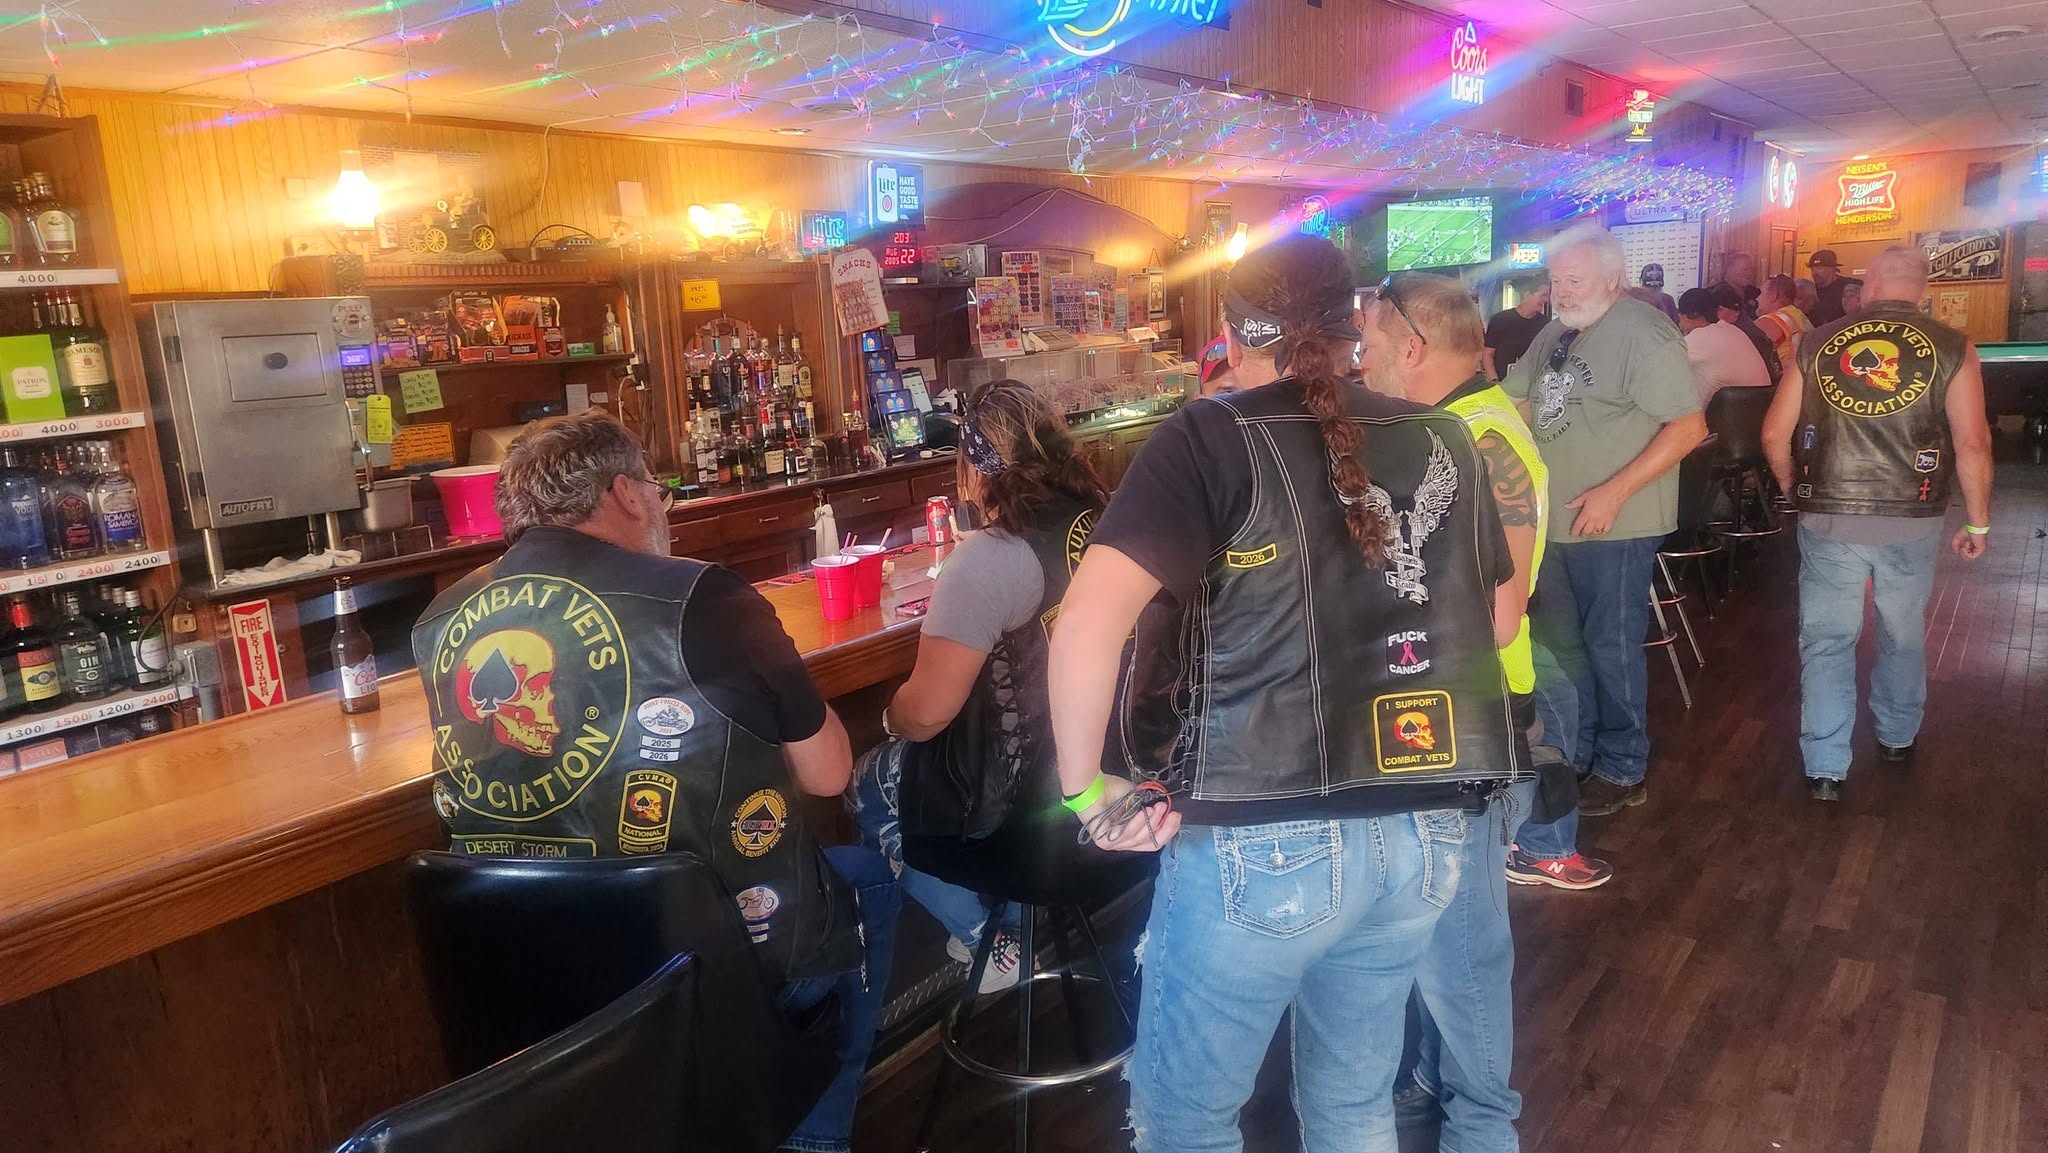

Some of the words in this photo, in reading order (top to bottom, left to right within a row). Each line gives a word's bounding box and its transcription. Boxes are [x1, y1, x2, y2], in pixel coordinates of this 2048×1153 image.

[1450, 26, 1488, 75] Coors
[1450, 72, 1486, 105] LIGHT
[879, 177, 896, 193] Lite
[899, 176, 915, 186] HAVE
[899, 186, 917, 196] GOOD
[1848, 179, 1887, 198] Miller
[899, 195, 919, 205] TASTE
[1844, 197, 1867, 207] HIGH
[1867, 195, 1886, 205] LIFE
[1634, 206, 1667, 216] ULTRA
[1835, 211, 1893, 225] HENDERSON
[837, 258, 871, 277] SNACKS
[18, 274, 55, 283] 4000
[1823, 323, 1899, 356] COMBAT
[1901, 325, 1932, 359] VETS
[1821, 373, 1928, 415] ASSOCIATION
[41, 422, 77, 434] 4000
[95, 417, 130, 428] 3000
[222, 499, 273, 516] AUTOFRY
[124, 555, 159, 569] 2400
[1240, 552, 1265, 564] 2026
[77, 564, 112, 578] 2400
[240, 616, 264, 633] FIRE
[440, 581, 562, 674] COMBAT
[562, 593, 618, 671] VETS
[1387, 630, 1428, 647] FUCK
[80, 655, 100, 668] GIN
[250, 634, 269, 697] EXTINGUISHER
[1389, 659, 1431, 675] CANCER
[360, 682, 377, 694] LIG
[142, 694, 177, 707] 2400
[1386, 701, 1390, 710] I
[1395, 697, 1438, 709] SUPPORT
[98, 702, 132, 718] 1200
[54, 712, 89, 728] 1500
[6, 725, 43, 741] 1300
[651, 739, 672, 748] 2025
[649, 751, 669, 760] 2026
[1384, 754, 1423, 766] COMBAT
[1425, 752, 1450, 762] VETS
[436, 722, 611, 813] ASSOCIATION
[638, 774, 665, 784] CVMA
[623, 826, 663, 838] NATIONAL
[465, 840, 516, 856] DESERT
[521, 843, 567, 858] STORM
[1546, 861, 1565, 874] N
